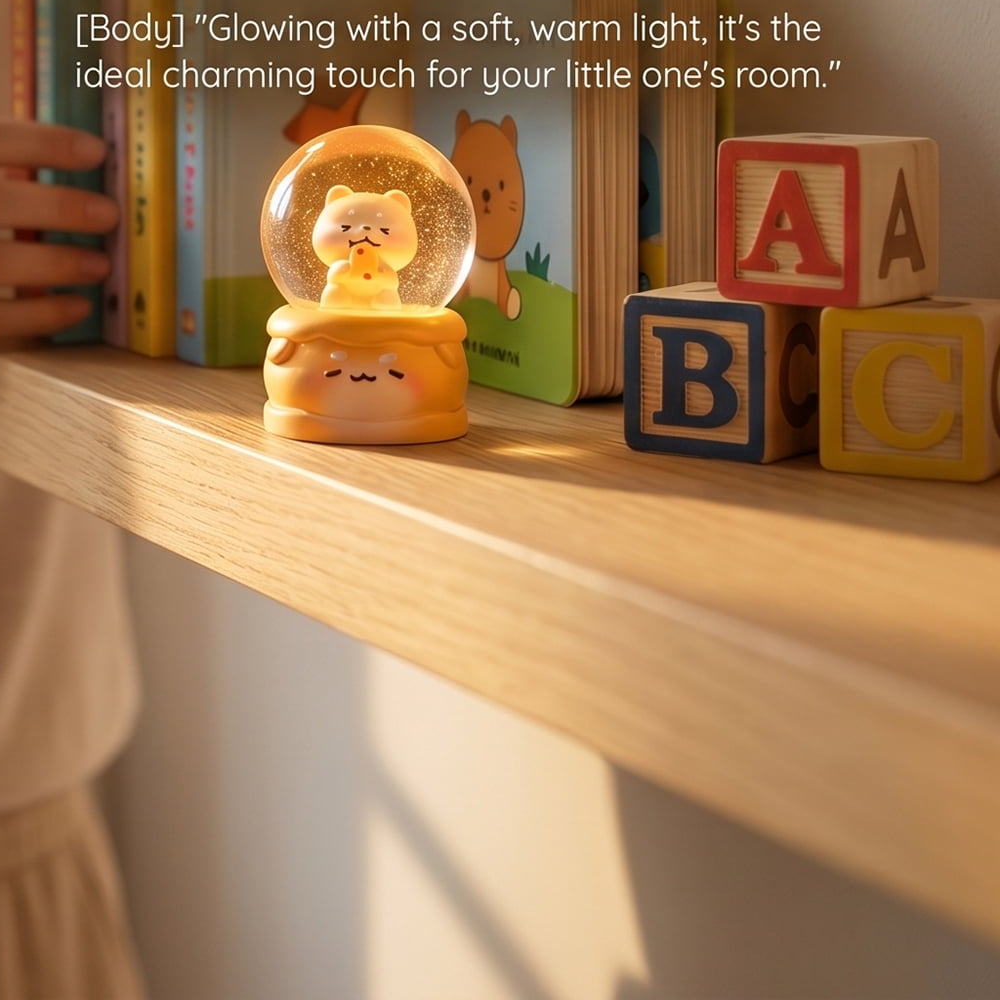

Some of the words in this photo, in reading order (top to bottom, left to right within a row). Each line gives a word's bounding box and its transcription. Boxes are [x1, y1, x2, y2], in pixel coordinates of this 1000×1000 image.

[738, 169, 842, 277] A
[878, 167, 926, 280] A
[652, 326, 738, 429] B
[853, 341, 955, 450] C
